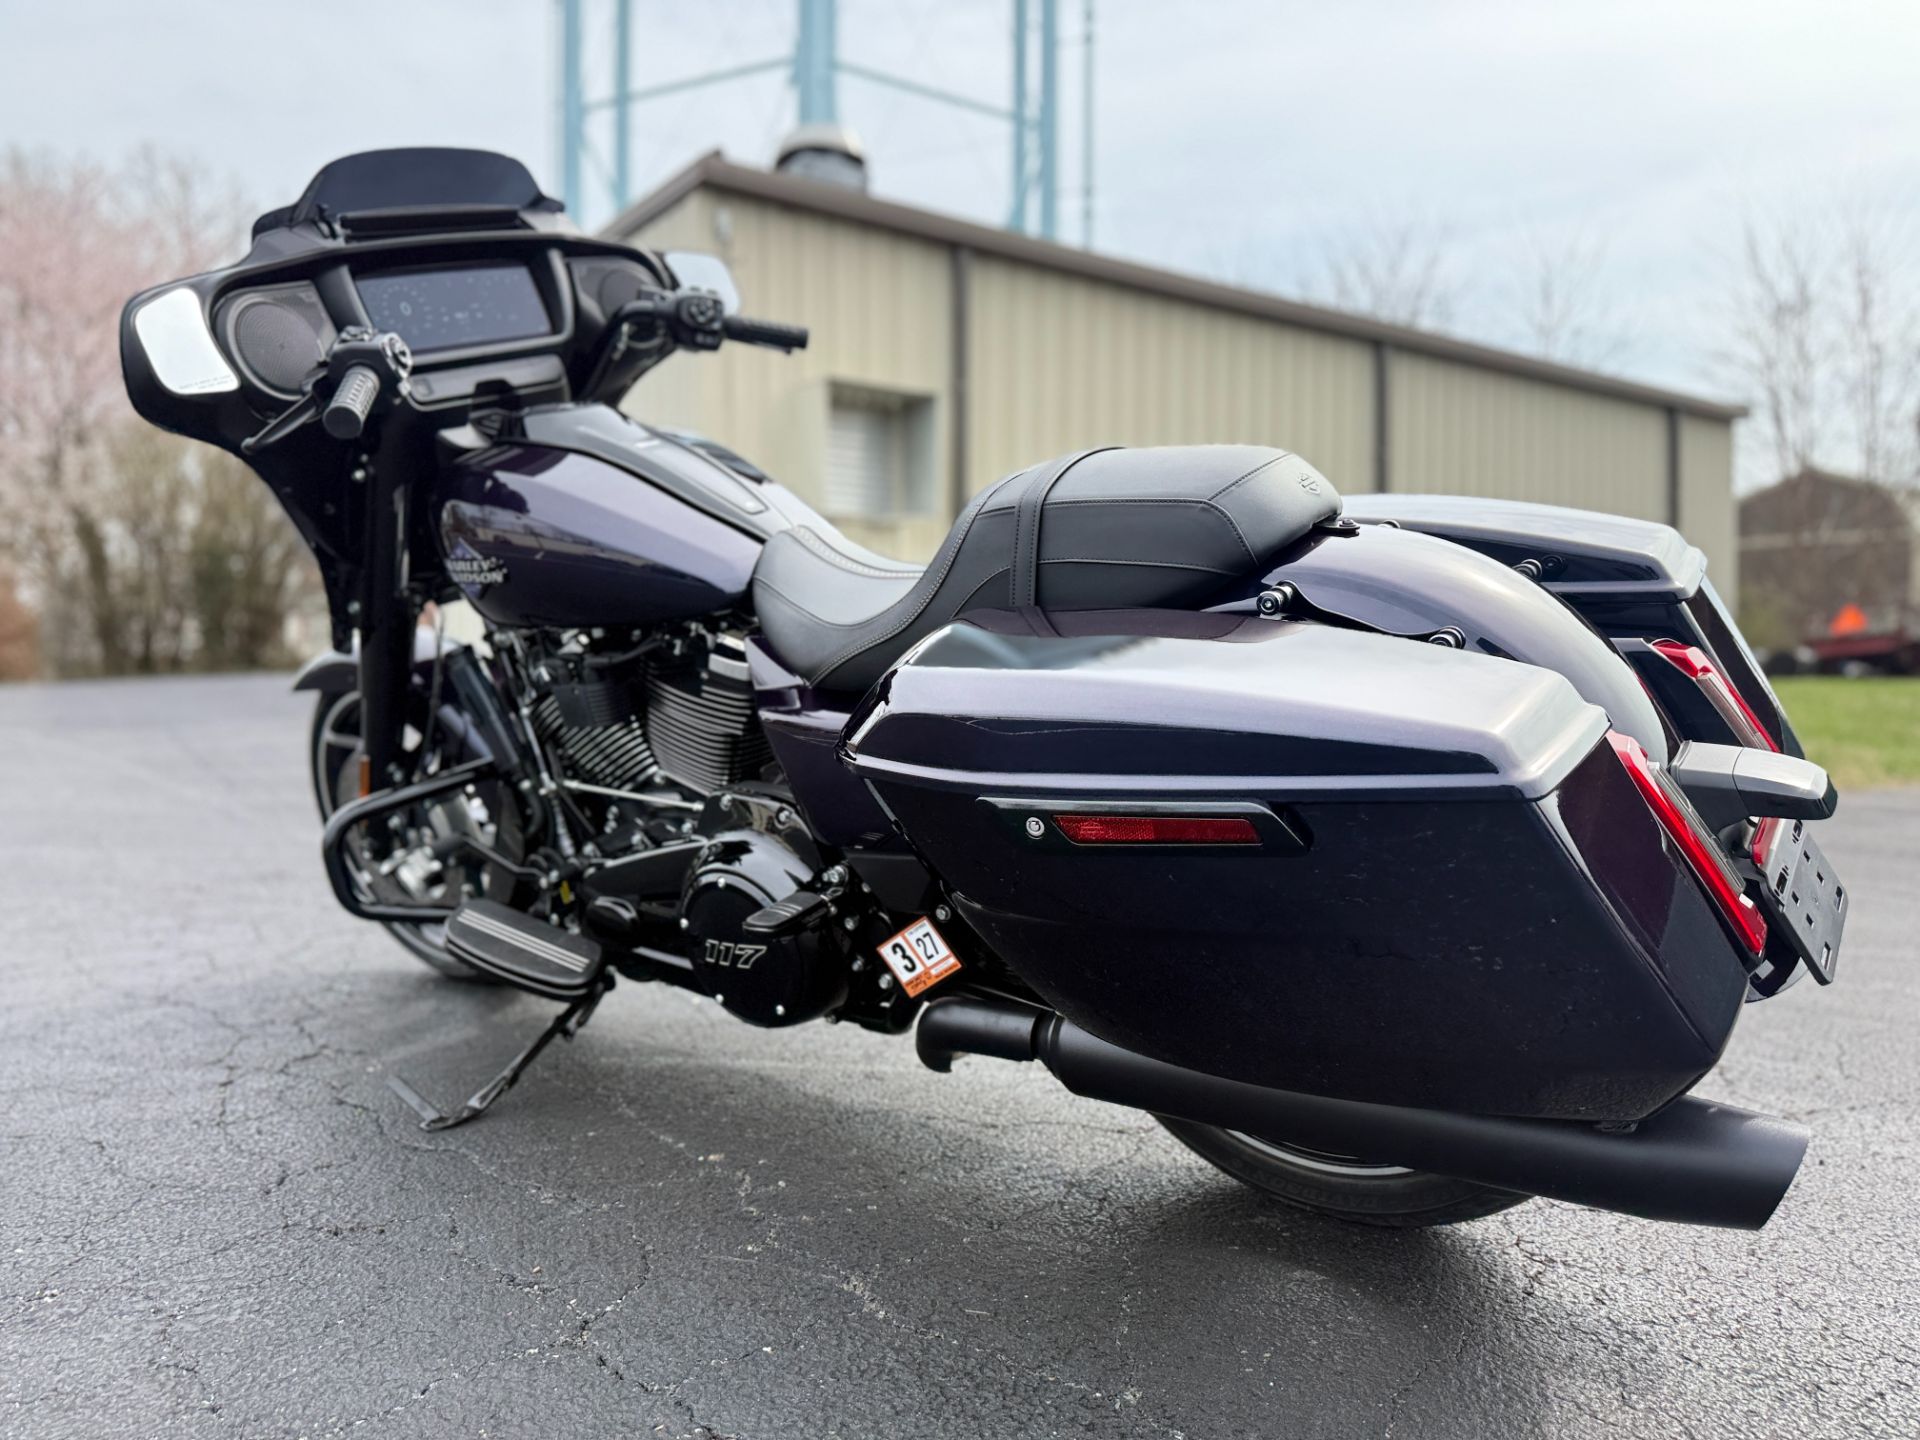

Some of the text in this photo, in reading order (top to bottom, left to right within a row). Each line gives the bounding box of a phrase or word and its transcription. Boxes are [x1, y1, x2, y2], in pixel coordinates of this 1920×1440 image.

[705, 938, 767, 969] 117
[891, 942, 917, 973] 3
[915, 931, 939, 960] 27
